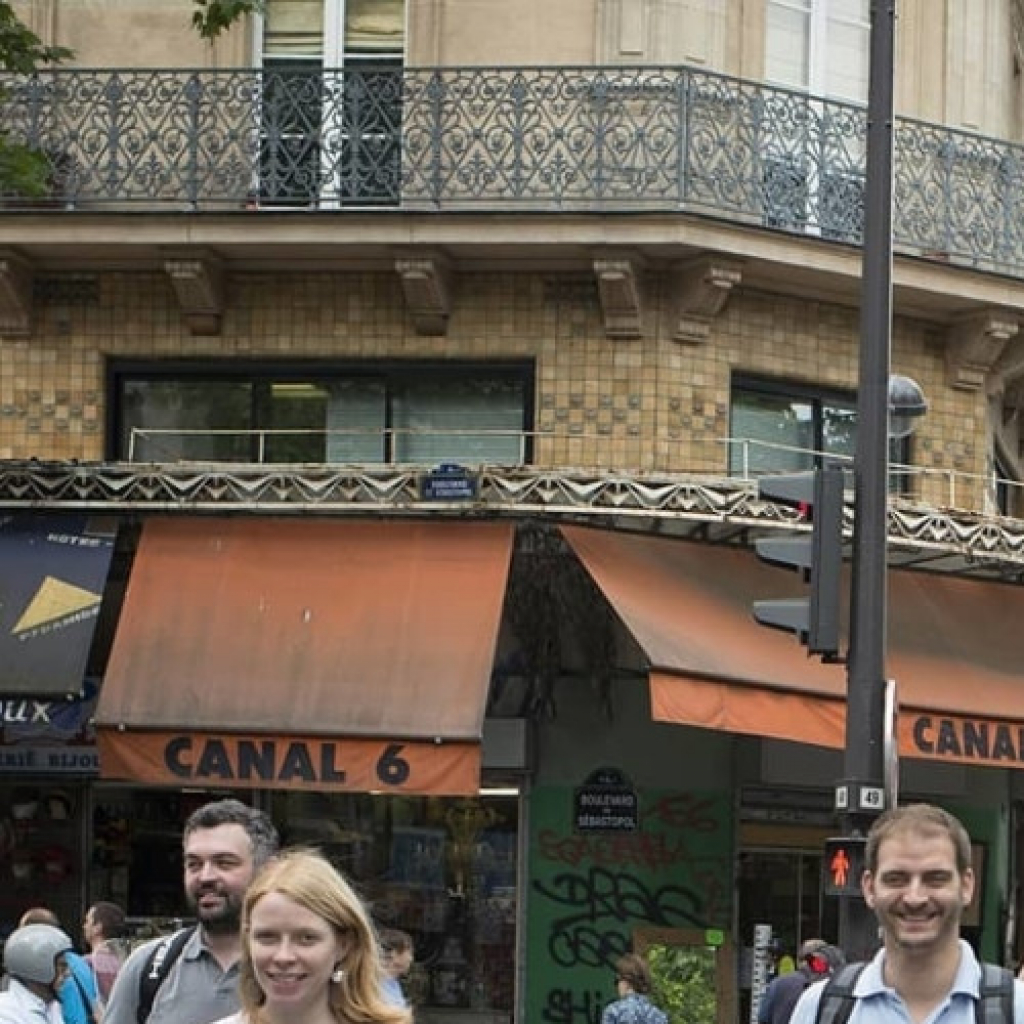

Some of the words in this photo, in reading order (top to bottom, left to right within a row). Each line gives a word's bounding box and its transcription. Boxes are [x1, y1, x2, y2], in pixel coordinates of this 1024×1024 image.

[164, 736, 346, 784] CANAL
[376, 743, 410, 786] 6
[580, 794, 634, 807] BOULEVARD
